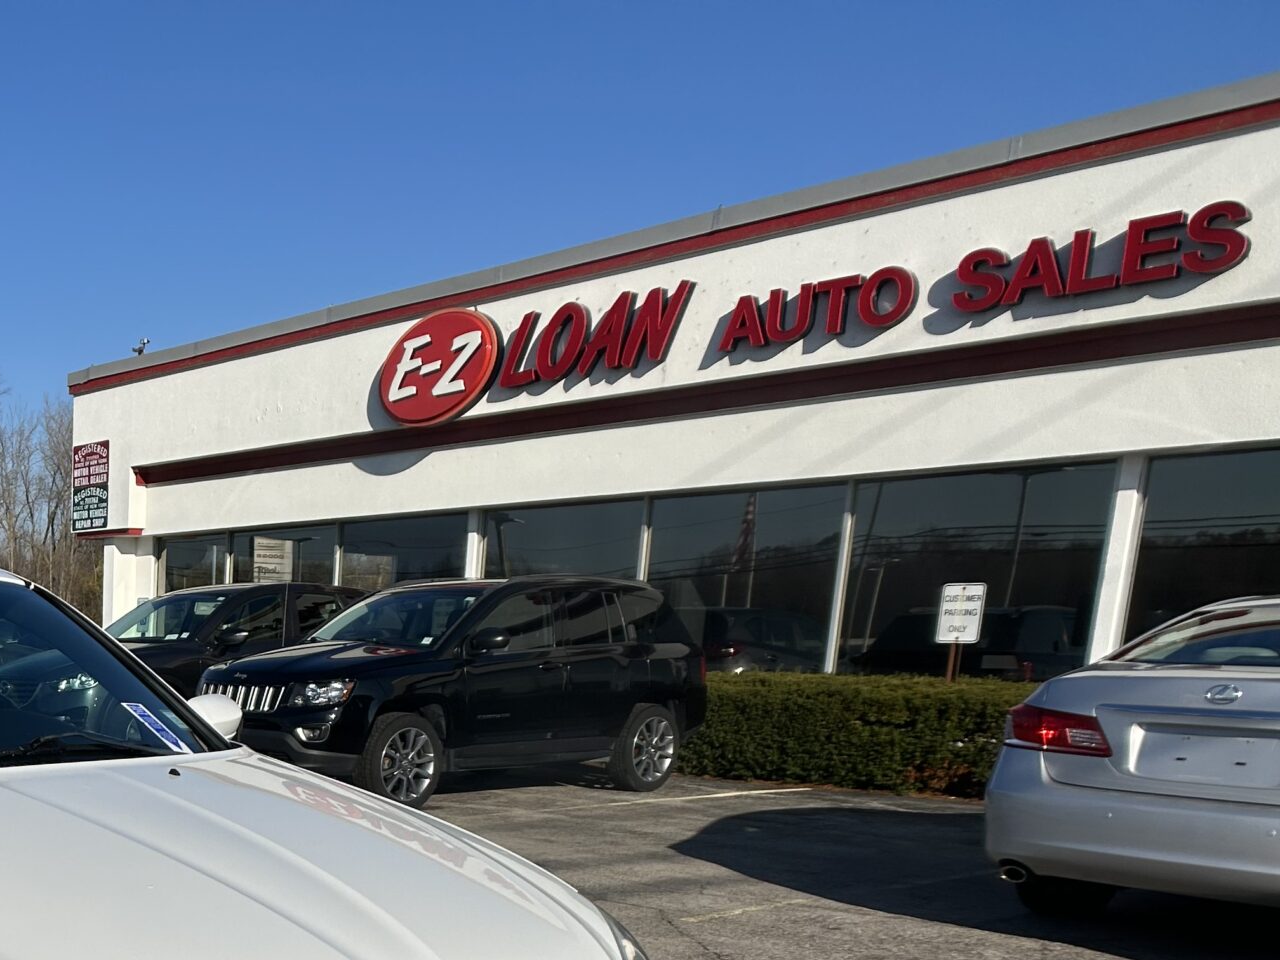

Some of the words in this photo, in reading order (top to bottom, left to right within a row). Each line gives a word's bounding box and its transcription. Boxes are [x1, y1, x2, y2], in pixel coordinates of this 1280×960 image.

[388, 330, 482, 403] E-Z
[500, 279, 698, 388] LOAN
[719, 266, 919, 352] AUTO
[953, 201, 1253, 313] SALES
[74, 443, 108, 462] REGISTERED
[73, 467, 89, 477] MOTOR
[90, 463, 108, 474] VEHICLE
[74, 476, 89, 487] RETAIL
[90, 473, 107, 484] DEALER
[74, 487, 107, 503] REGISTERED
[90, 508, 107, 517] VEHICLE
[76, 519, 91, 528] REPAIR
[93, 518, 104, 527] SHOP
[944, 594, 983, 602] CUSTOMER
[944, 608, 978, 616] PARKING
[948, 624, 967, 632] ONLY
